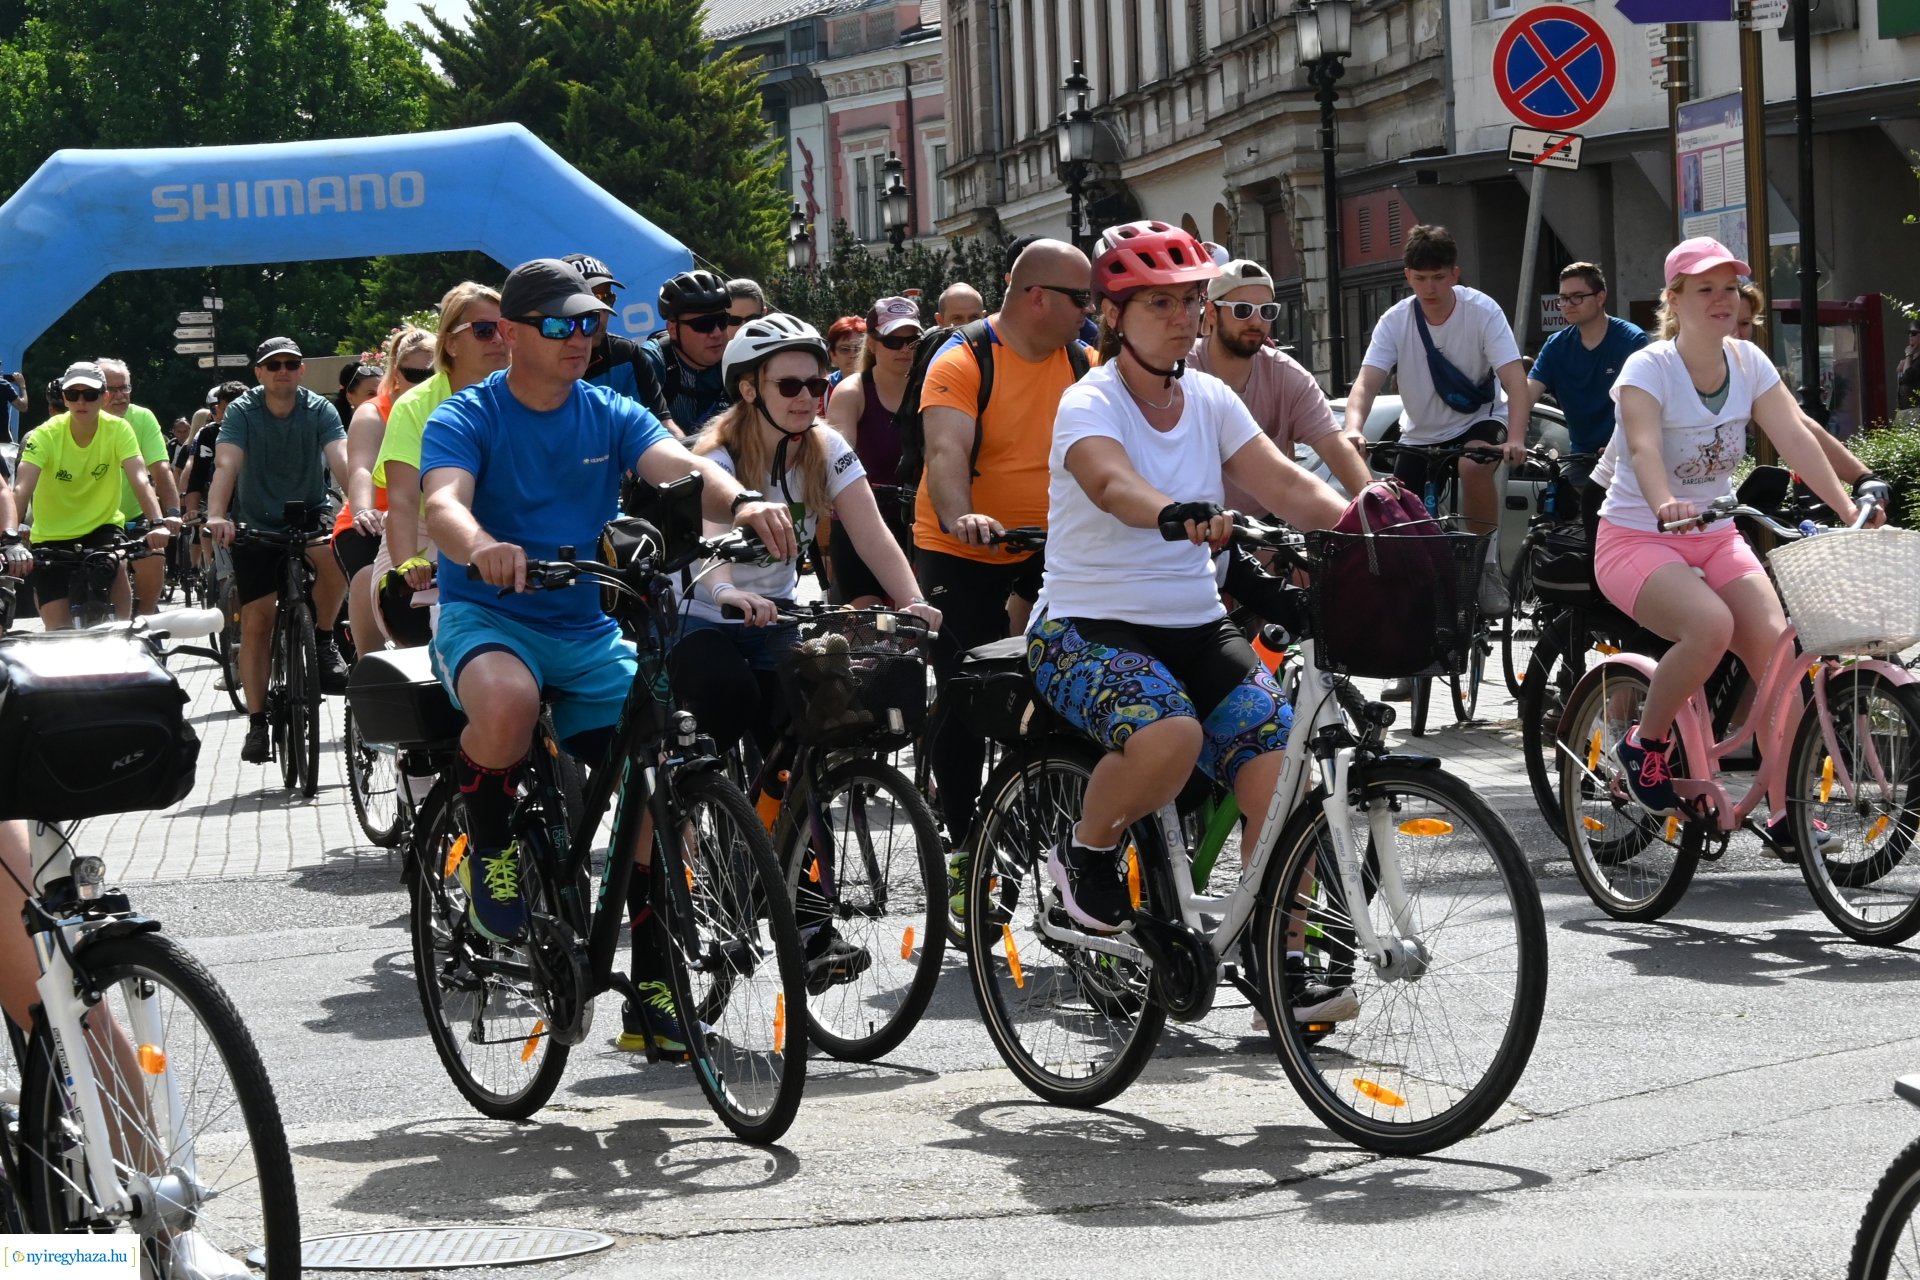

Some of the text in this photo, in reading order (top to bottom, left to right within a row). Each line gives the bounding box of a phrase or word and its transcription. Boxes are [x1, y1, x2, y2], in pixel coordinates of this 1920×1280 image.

[151, 171, 425, 223] SHIMANO
[1682, 477, 1716, 485] BARCELONA
[111, 749, 144, 770] KLS
